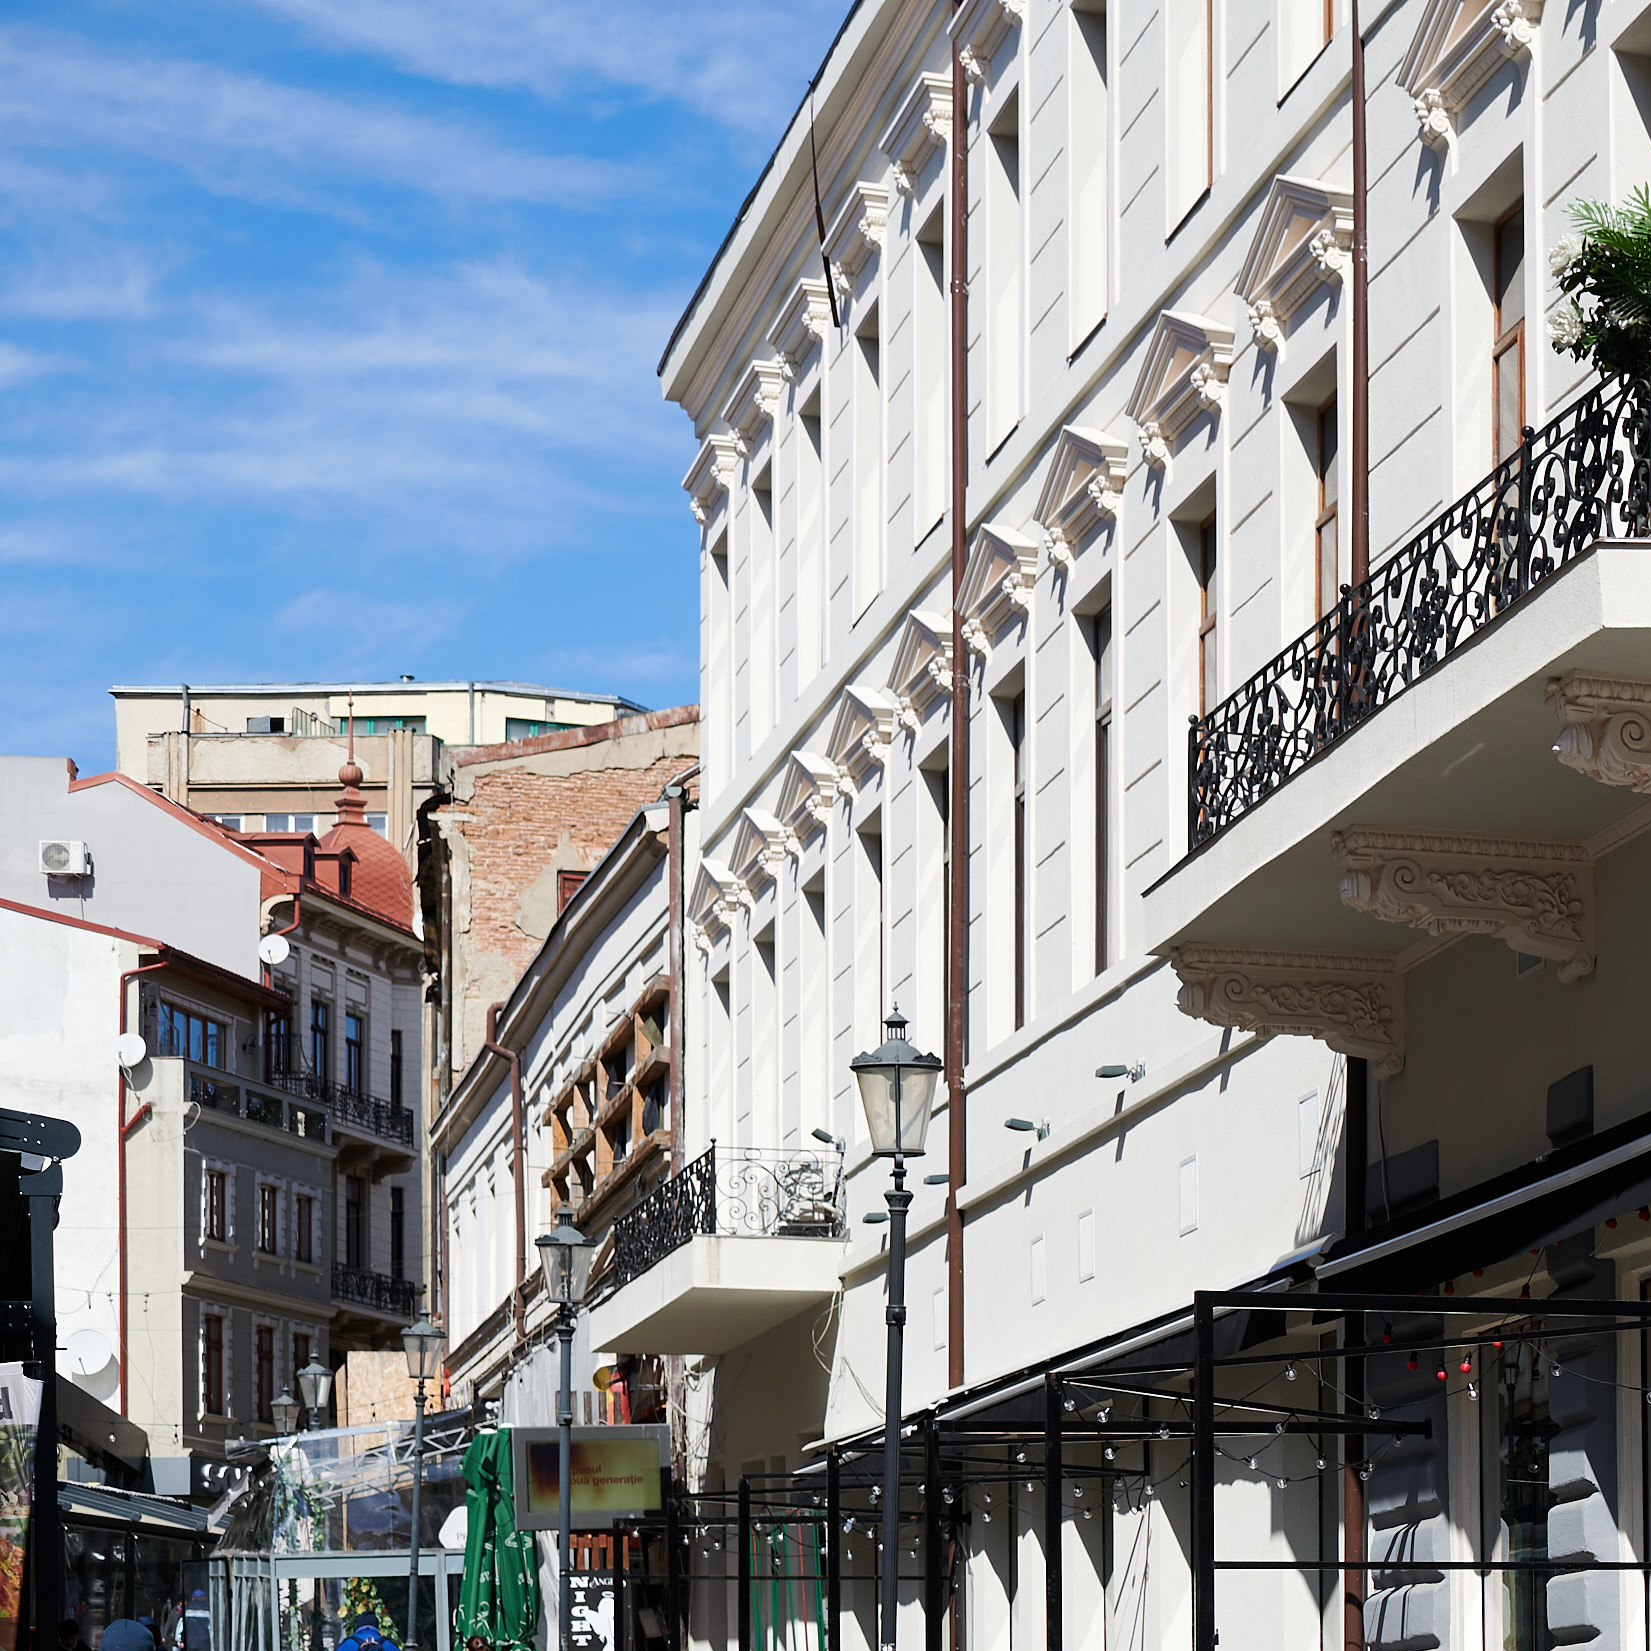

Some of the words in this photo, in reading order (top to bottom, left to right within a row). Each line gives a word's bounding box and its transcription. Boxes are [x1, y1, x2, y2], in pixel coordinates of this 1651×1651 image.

[571, 1465, 601, 1476] pasul
[569, 1477, 590, 1485] oua
[569, 1576, 592, 1647] NIGHT
